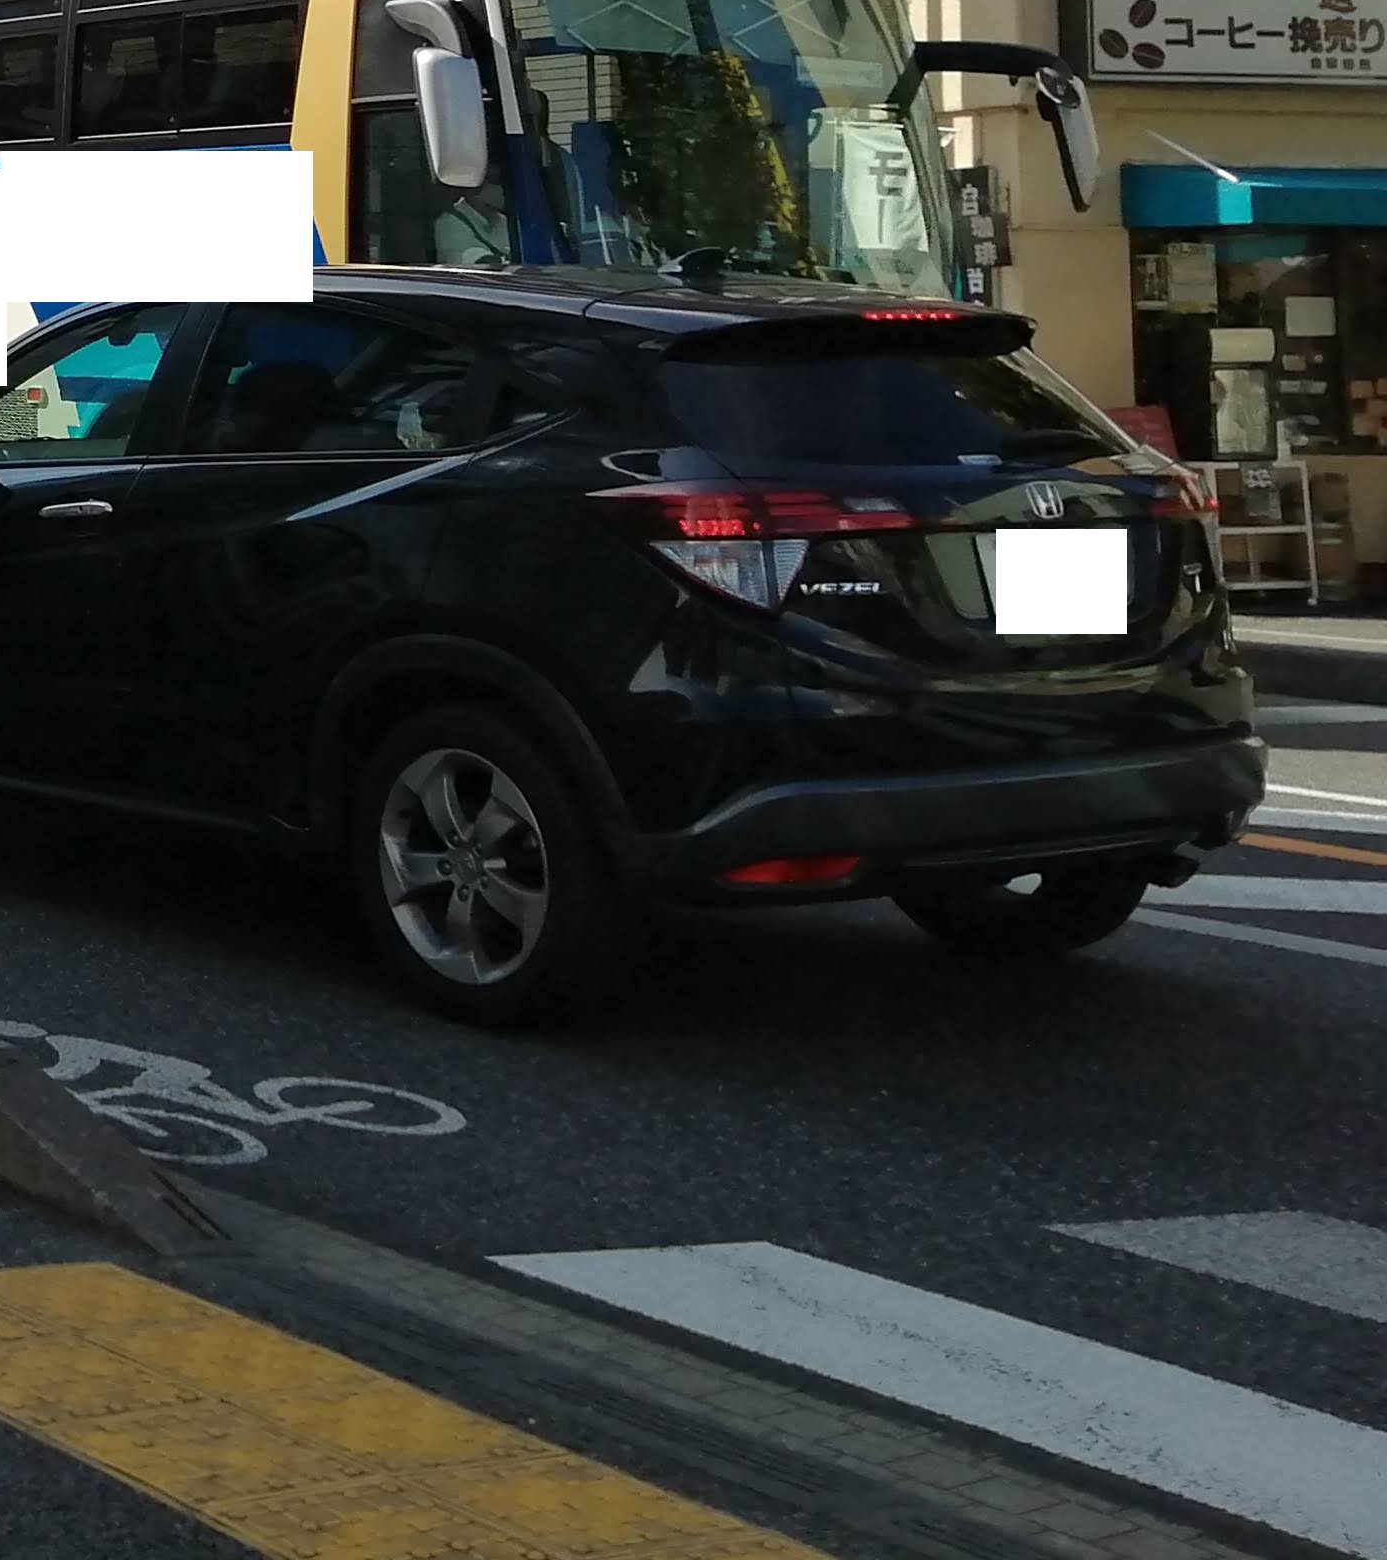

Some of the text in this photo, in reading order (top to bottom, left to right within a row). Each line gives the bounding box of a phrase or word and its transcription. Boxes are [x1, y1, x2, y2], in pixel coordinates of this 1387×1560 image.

[1163, 15, 1386, 54] コーヒー挽売り
[799, 581, 886, 595] VEZEL
